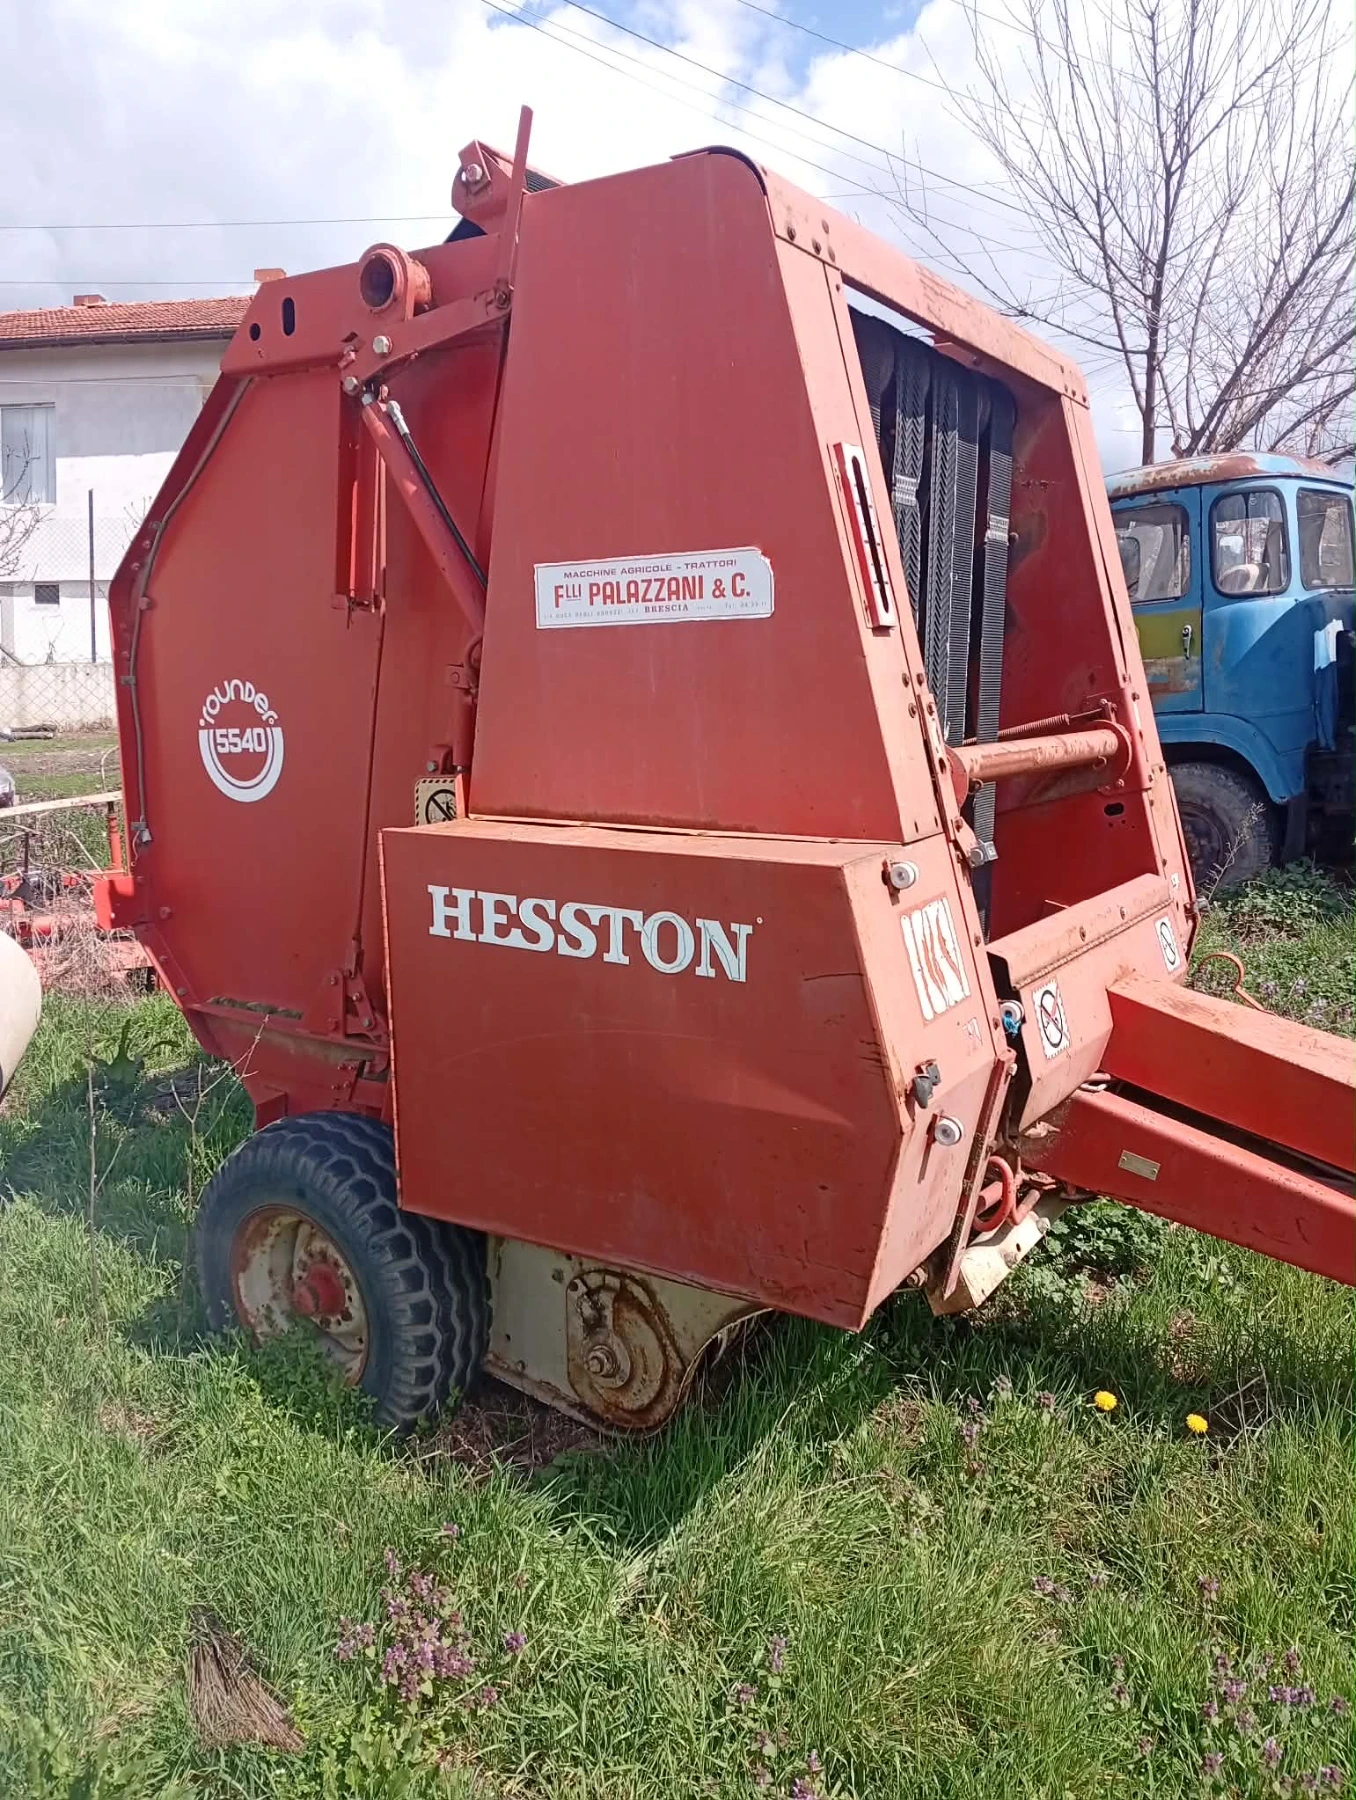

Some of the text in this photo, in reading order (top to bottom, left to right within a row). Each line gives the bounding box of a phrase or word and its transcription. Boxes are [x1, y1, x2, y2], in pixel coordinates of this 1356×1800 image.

[563, 568, 617, 579] MACCHINE
[620, 564, 672, 575] AGRICOLE
[684, 559, 737, 570] TRATTORI
[588, 575, 704, 606] PALAZZANI
[711, 578, 727, 599] &
[731, 572, 751, 598] C.
[644, 604, 689, 613] BRESCIA
[215, 727, 267, 753] 5540
[427, 884, 753, 982] HESSTON
